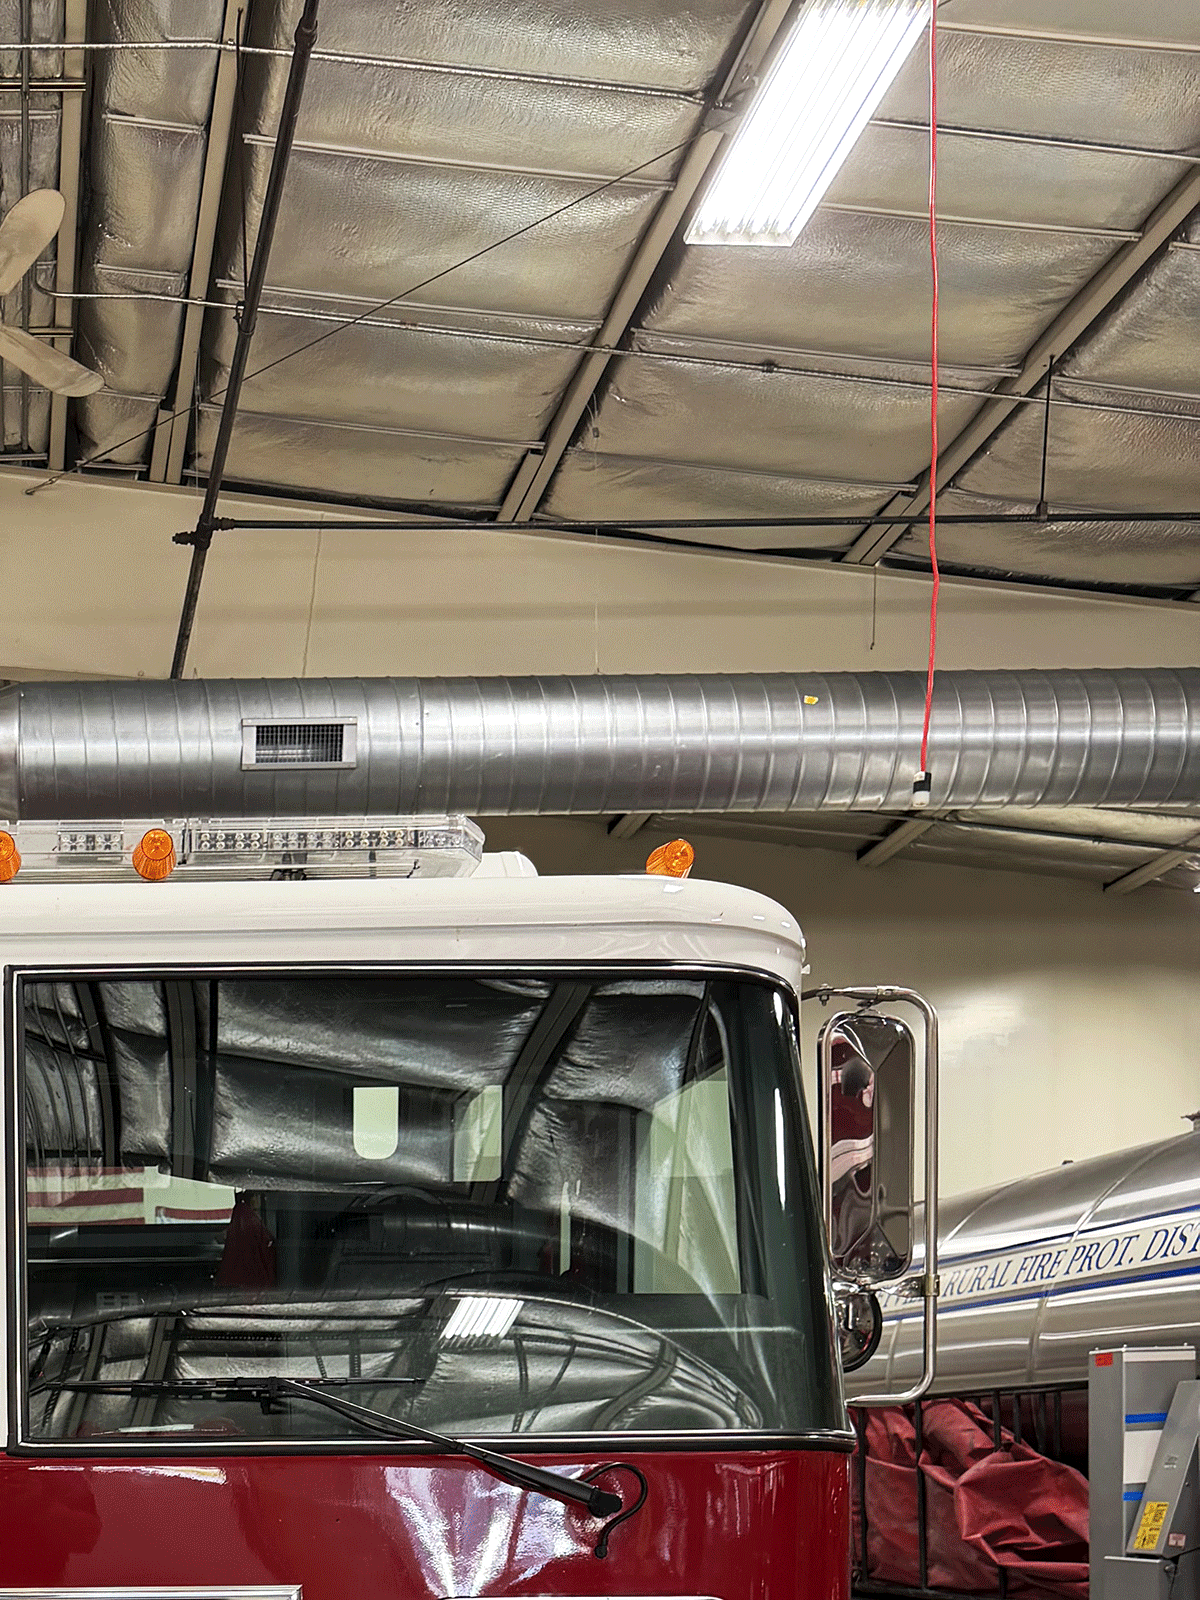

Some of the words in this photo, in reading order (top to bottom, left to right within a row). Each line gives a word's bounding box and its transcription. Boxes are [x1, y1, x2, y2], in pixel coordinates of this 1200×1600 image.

[941, 1259, 1013, 1298] RURAL
[1011, 1248, 1069, 1286] FIRE
[1063, 1234, 1141, 1276] PROT.
